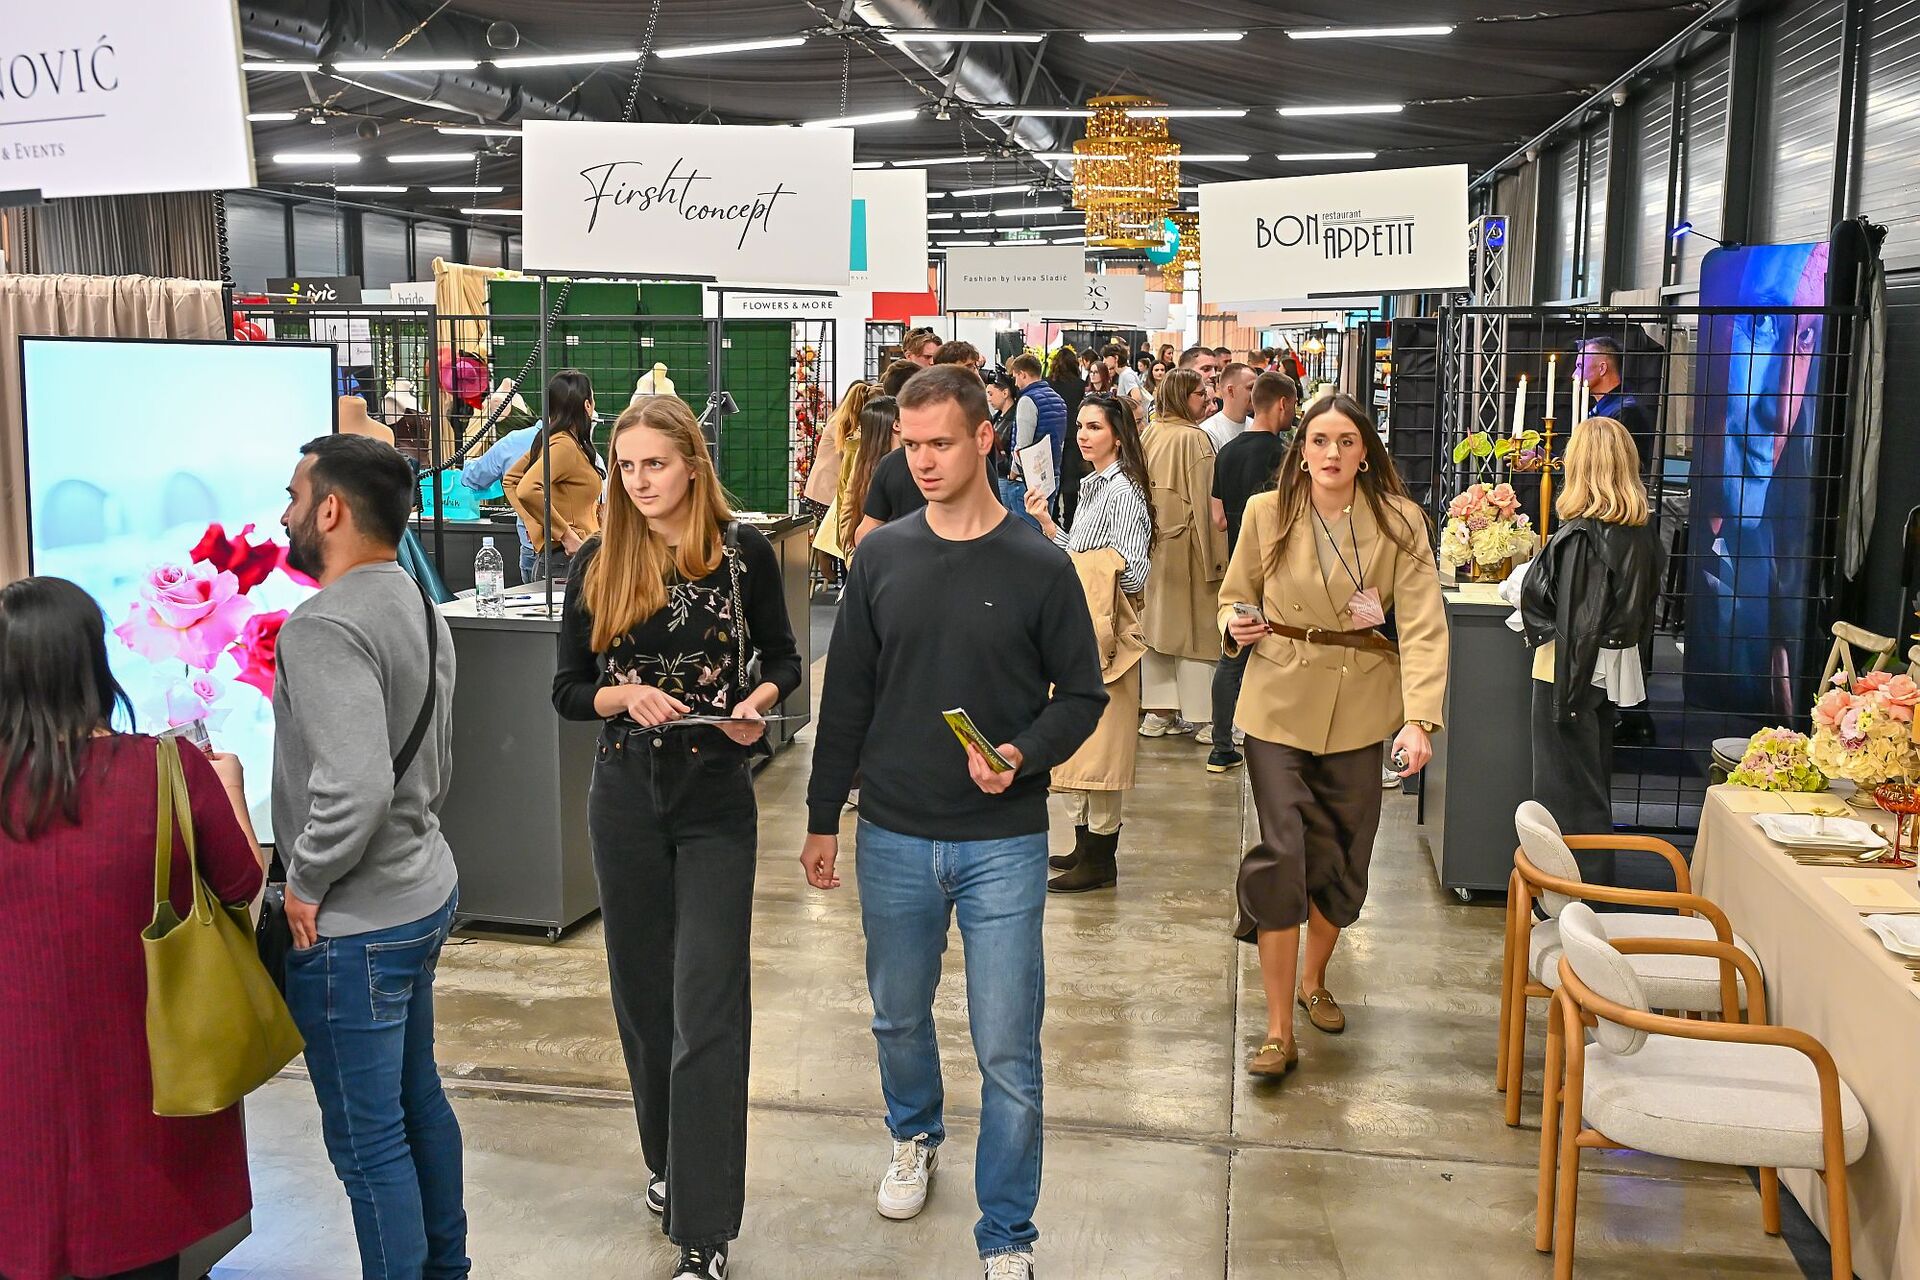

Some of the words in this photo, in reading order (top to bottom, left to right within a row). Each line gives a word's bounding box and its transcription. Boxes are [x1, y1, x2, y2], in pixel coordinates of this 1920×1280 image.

[0, 34, 118, 100] OVIĆ
[580, 157, 712, 233] Firsht
[684, 183, 797, 250] concept
[1322, 210, 1362, 220] restaurant
[1257, 214, 1319, 248] BON
[1323, 223, 1415, 259] APPETIT
[1000, 275, 1010, 283] by
[742, 301, 790, 310] FLOWERS
[792, 302, 799, 310] &
[801, 301, 834, 310] MORE
